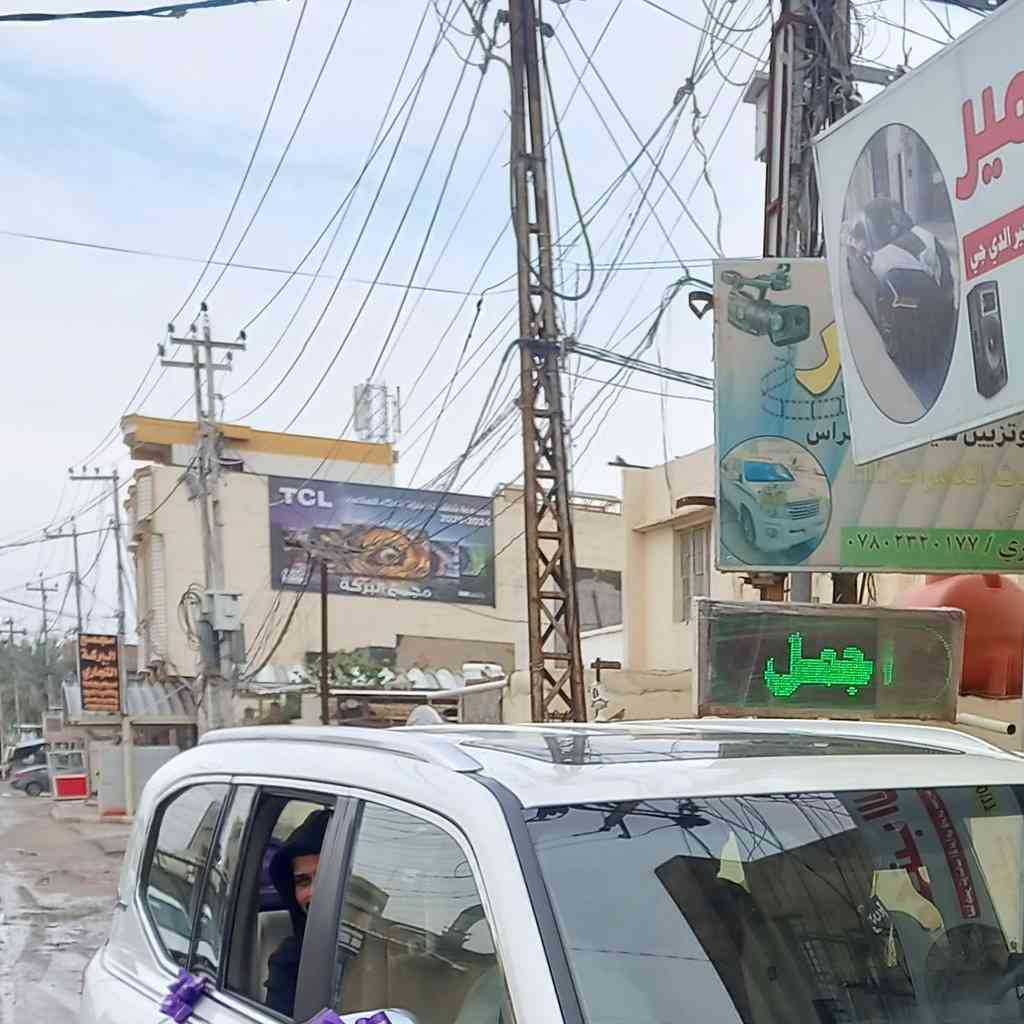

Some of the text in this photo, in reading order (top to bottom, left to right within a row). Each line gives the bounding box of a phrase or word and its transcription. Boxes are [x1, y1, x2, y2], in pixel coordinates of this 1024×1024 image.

[970, 243, 987, 274] جي
[988, 226, 1012, 265] الدي
[278, 487, 333, 508] TCL
